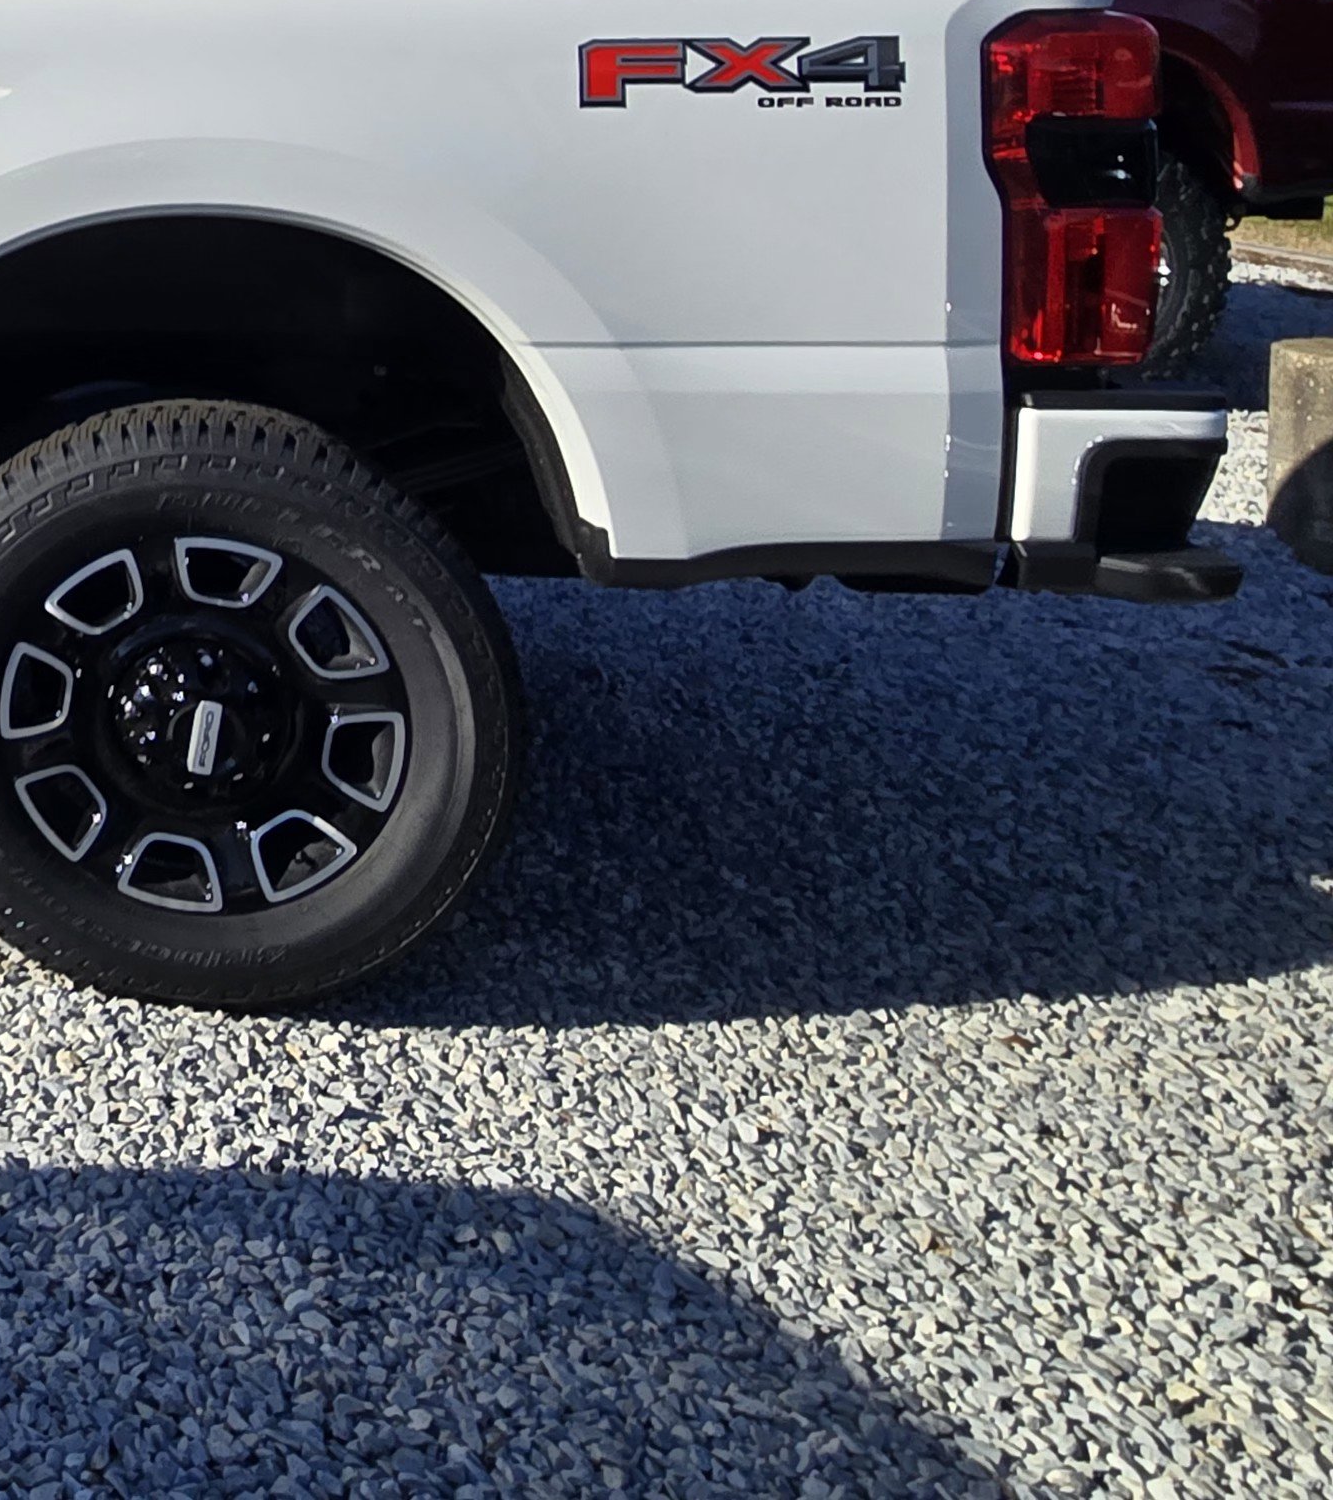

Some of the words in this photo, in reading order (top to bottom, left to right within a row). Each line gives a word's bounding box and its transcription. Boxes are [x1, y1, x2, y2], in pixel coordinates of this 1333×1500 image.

[578, 35, 906, 108] FX4
[757, 96, 815, 108] OFF
[825, 96, 902, 108] ROAD
